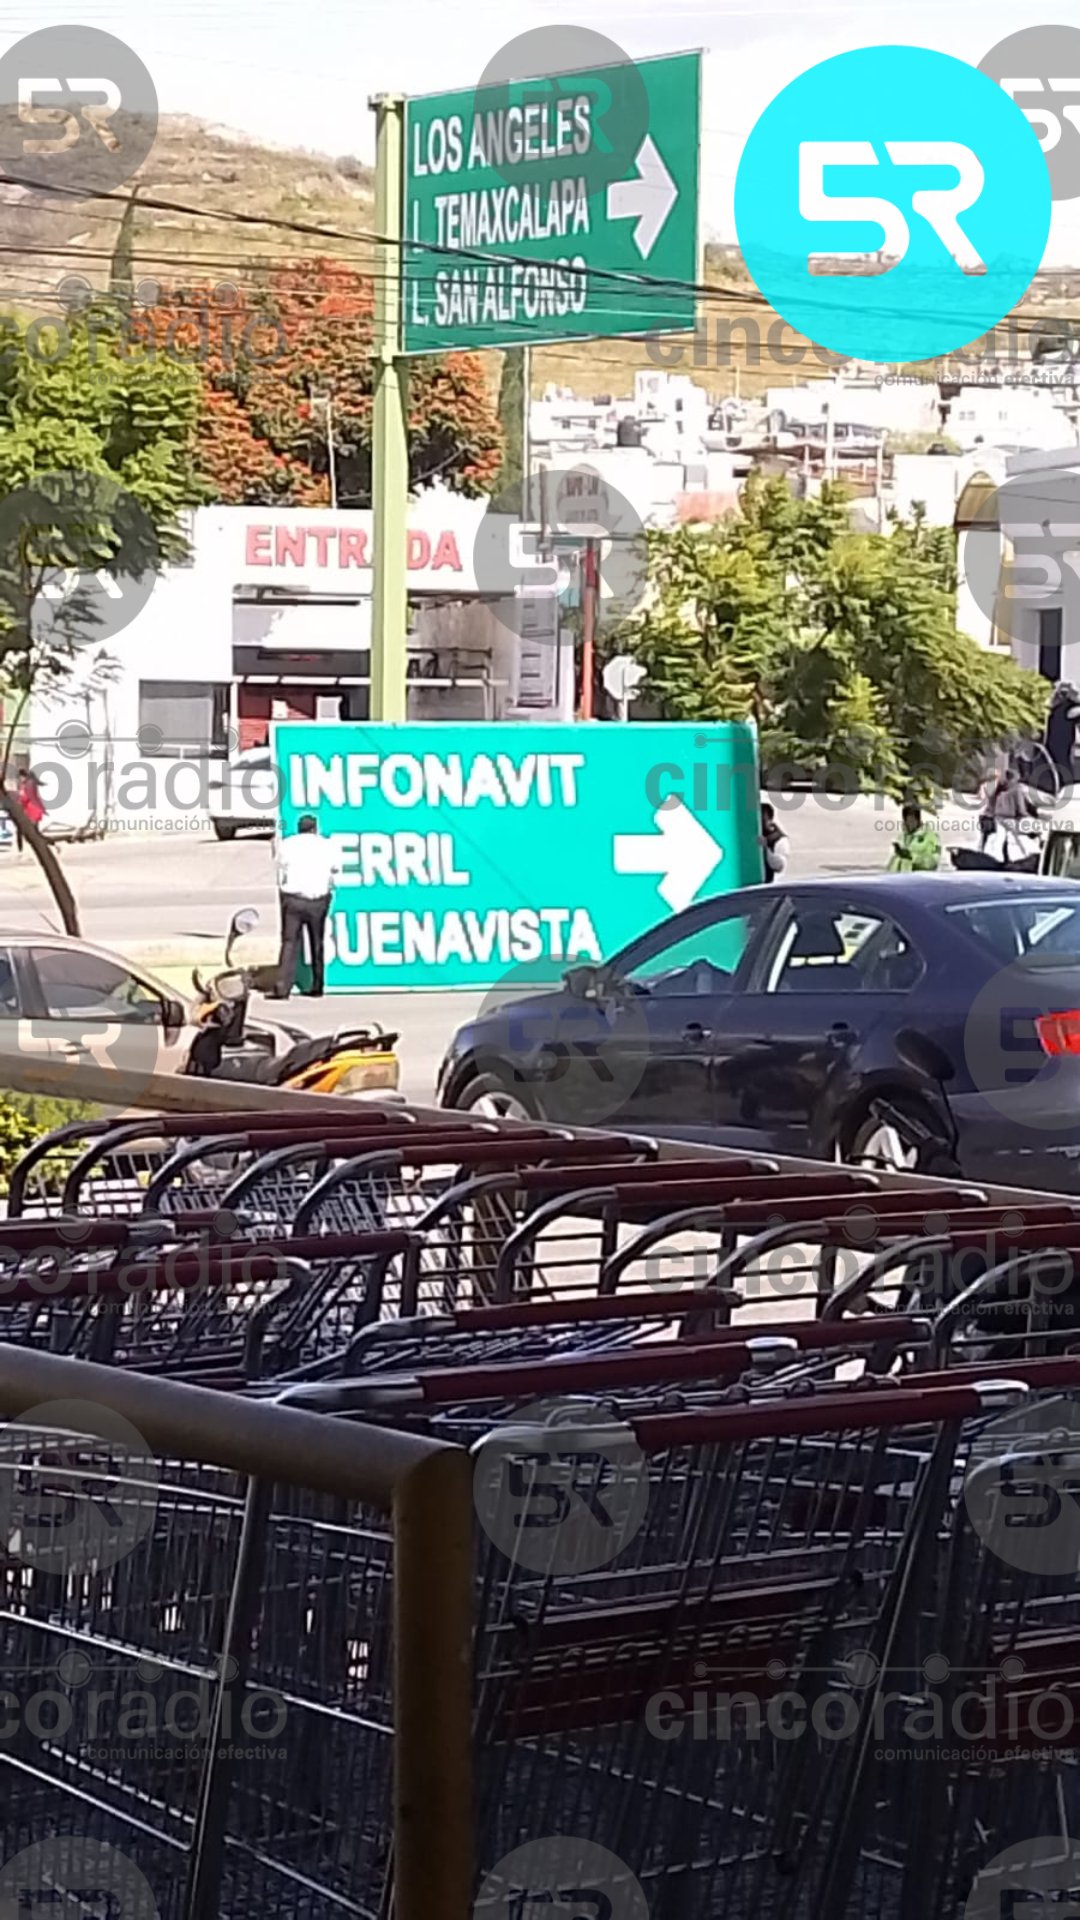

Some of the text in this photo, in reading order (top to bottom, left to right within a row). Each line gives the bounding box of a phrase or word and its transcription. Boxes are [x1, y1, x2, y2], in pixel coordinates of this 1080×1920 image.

[413, 96, 591, 176] LOS ANGELES
[434, 177, 590, 250] TEMAXCALAPA
[412, 255, 587, 326] L. SAN ALFONSO
[245, 524, 463, 572] ENTRDA
[289, 753, 586, 808] INFONAVIT
[328, 831, 471, 887] ERRIL
